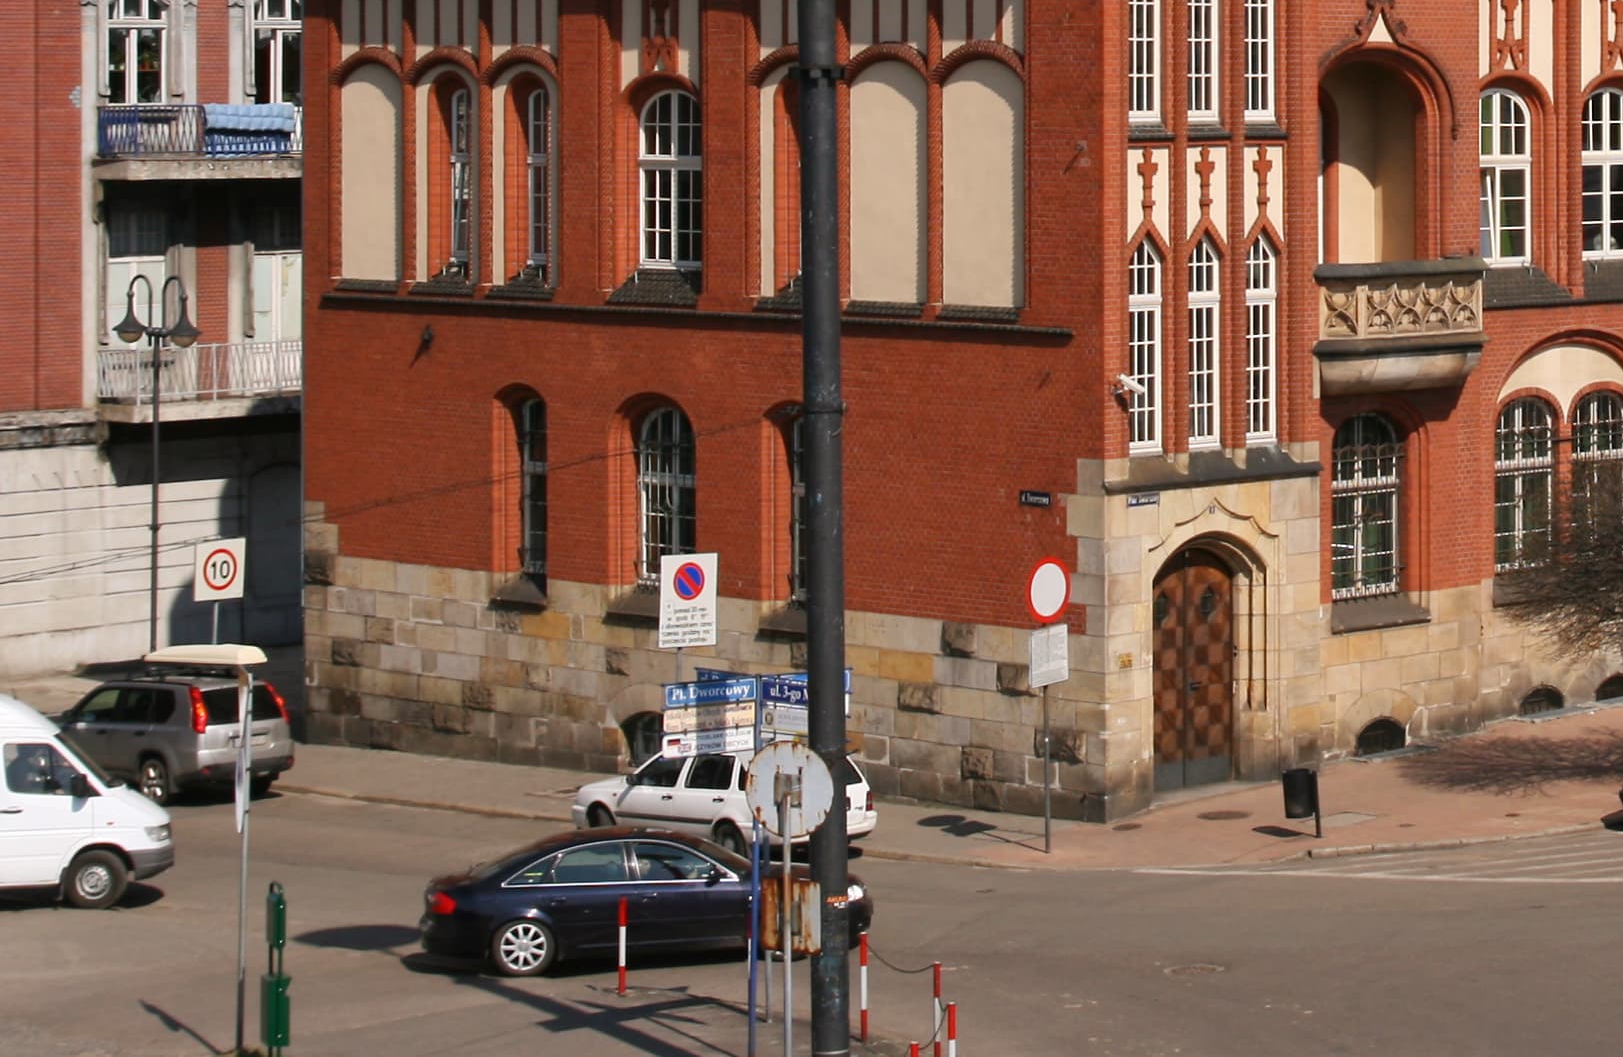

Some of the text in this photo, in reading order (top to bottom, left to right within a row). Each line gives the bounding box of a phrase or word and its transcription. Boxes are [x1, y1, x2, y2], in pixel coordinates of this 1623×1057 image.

[211, 559, 230, 580] 10
[672, 685, 751, 701] Pl. Dworcowy
[770, 684, 781, 697] ul.
[782, 685, 802, 703] 3-go
